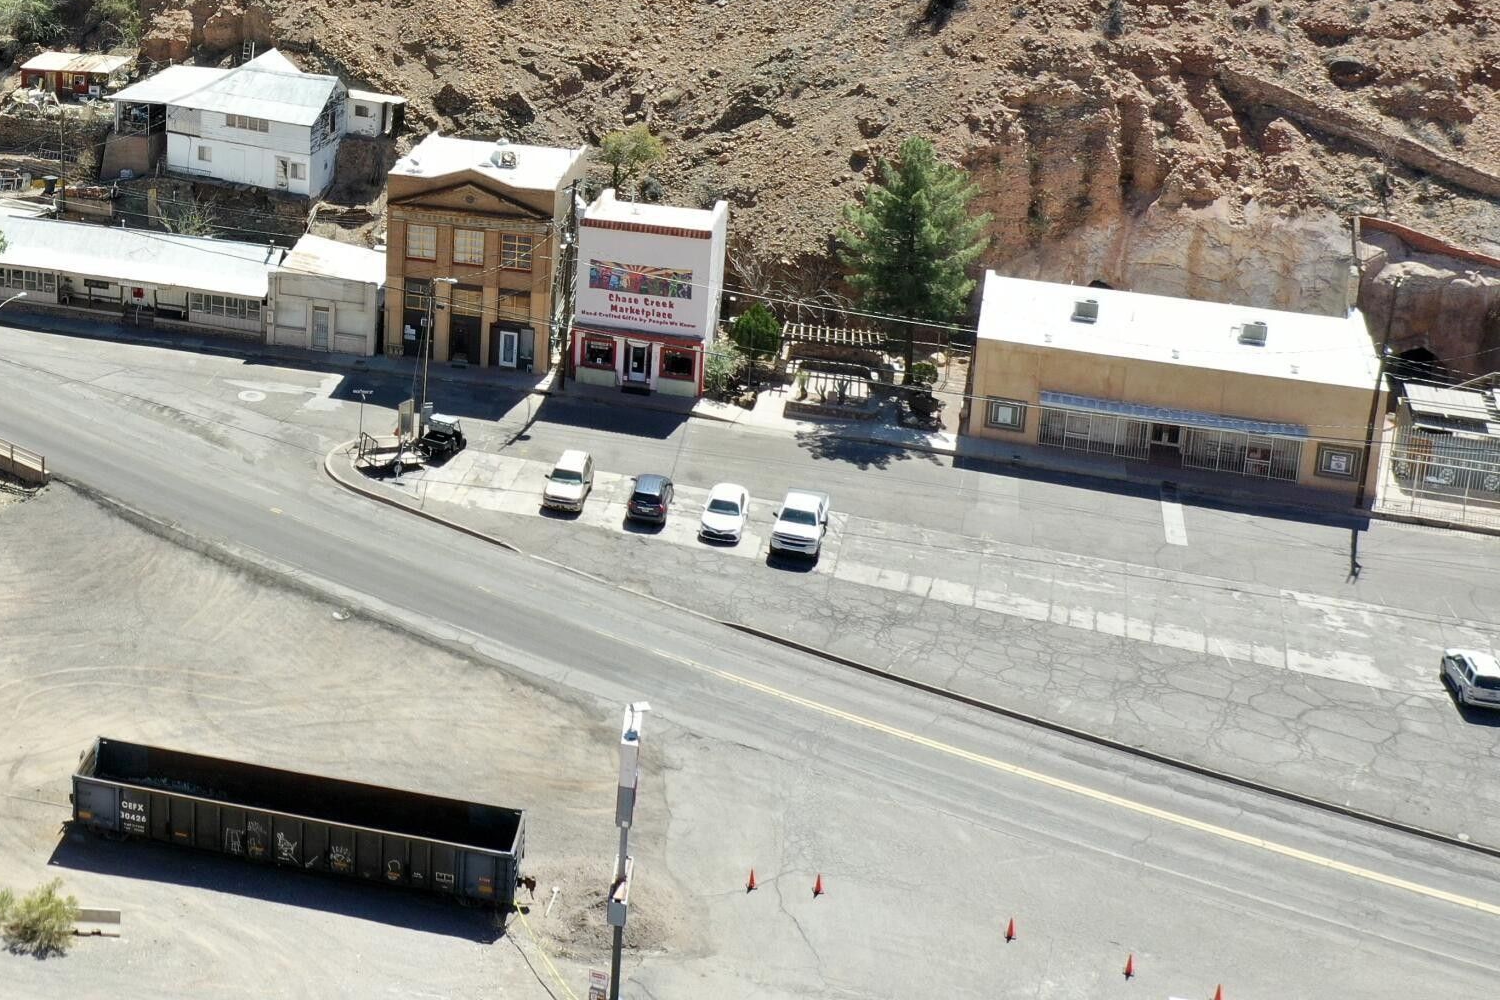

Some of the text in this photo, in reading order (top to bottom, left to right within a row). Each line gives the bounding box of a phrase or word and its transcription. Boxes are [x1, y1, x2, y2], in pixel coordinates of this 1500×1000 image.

[608, 293, 675, 309] Chase Creek
[610, 304, 673, 319] Marketplace
[648, 318, 669, 326] People
